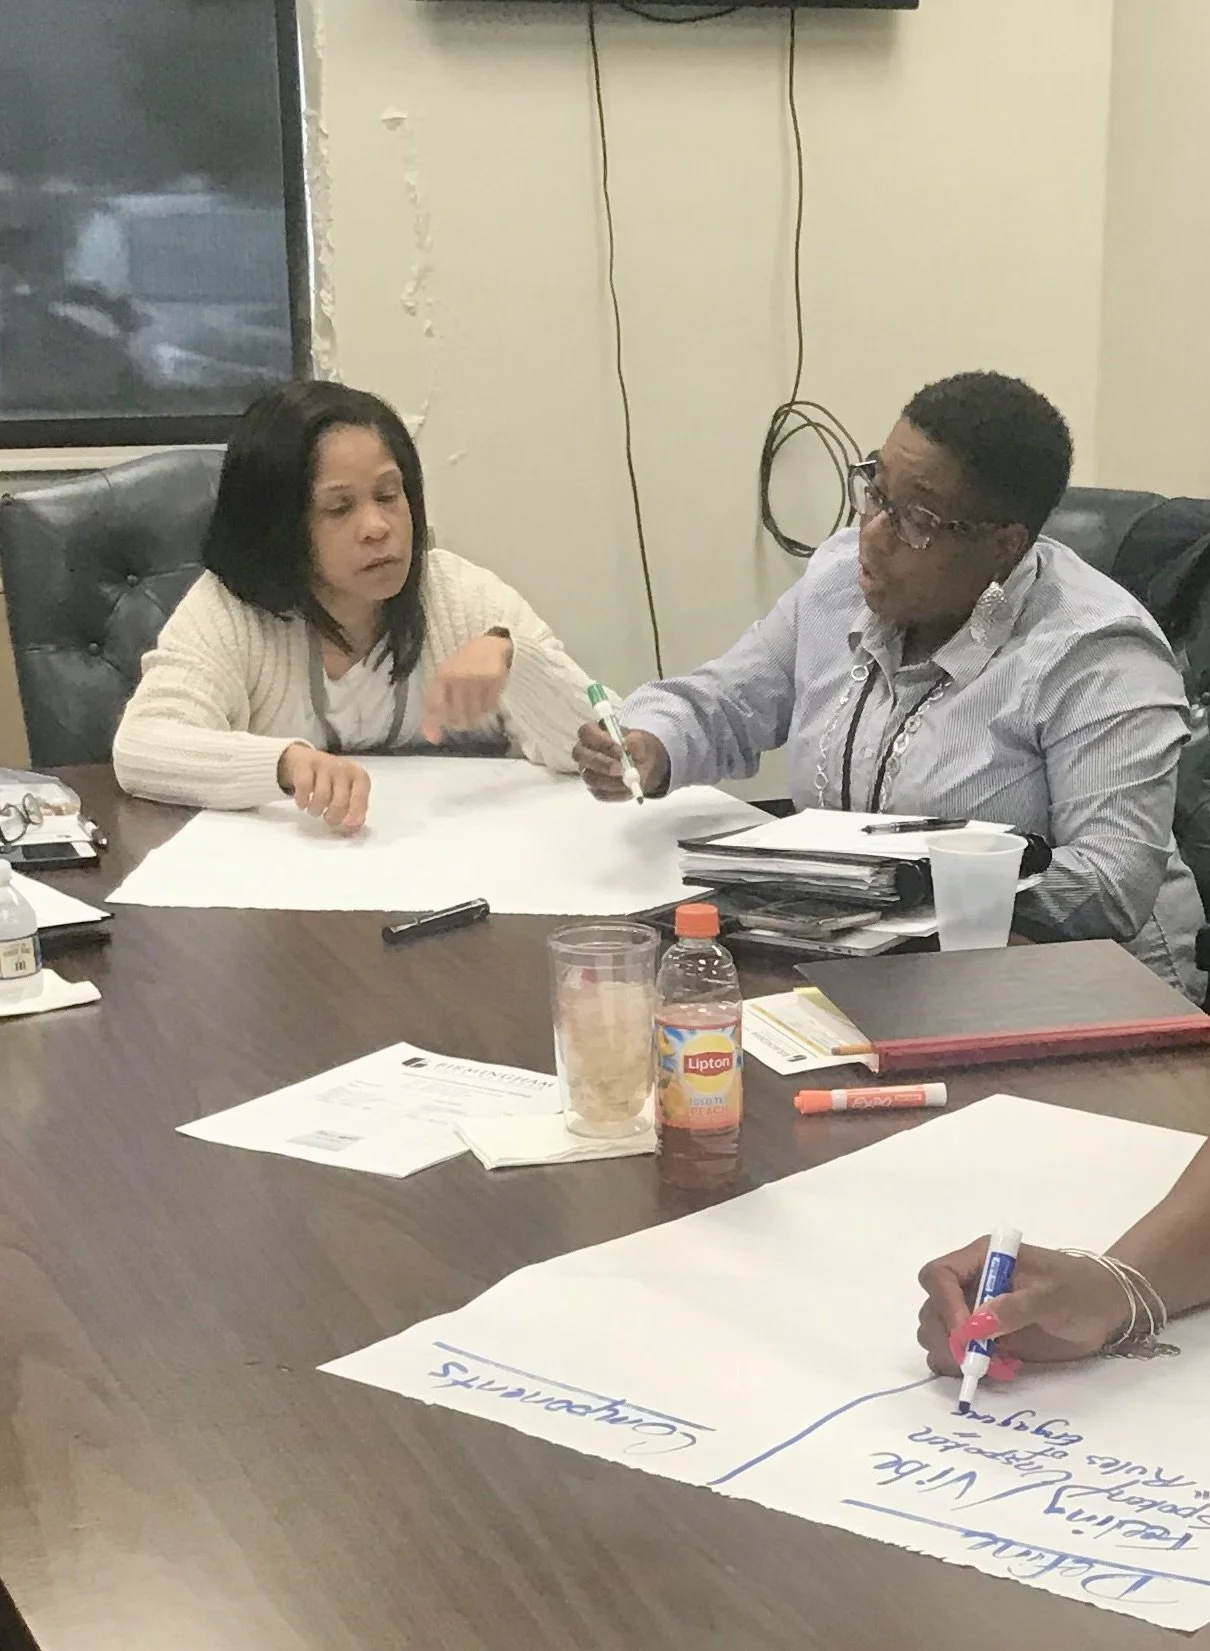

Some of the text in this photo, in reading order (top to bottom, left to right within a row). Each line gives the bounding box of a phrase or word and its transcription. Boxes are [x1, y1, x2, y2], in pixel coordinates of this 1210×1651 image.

[688, 1057, 730, 1072] Lipton
[428, 1361, 697, 1455] Components
[869, 1452, 977, 1500] Vibe
[960, 1530, 1180, 1604] Define
